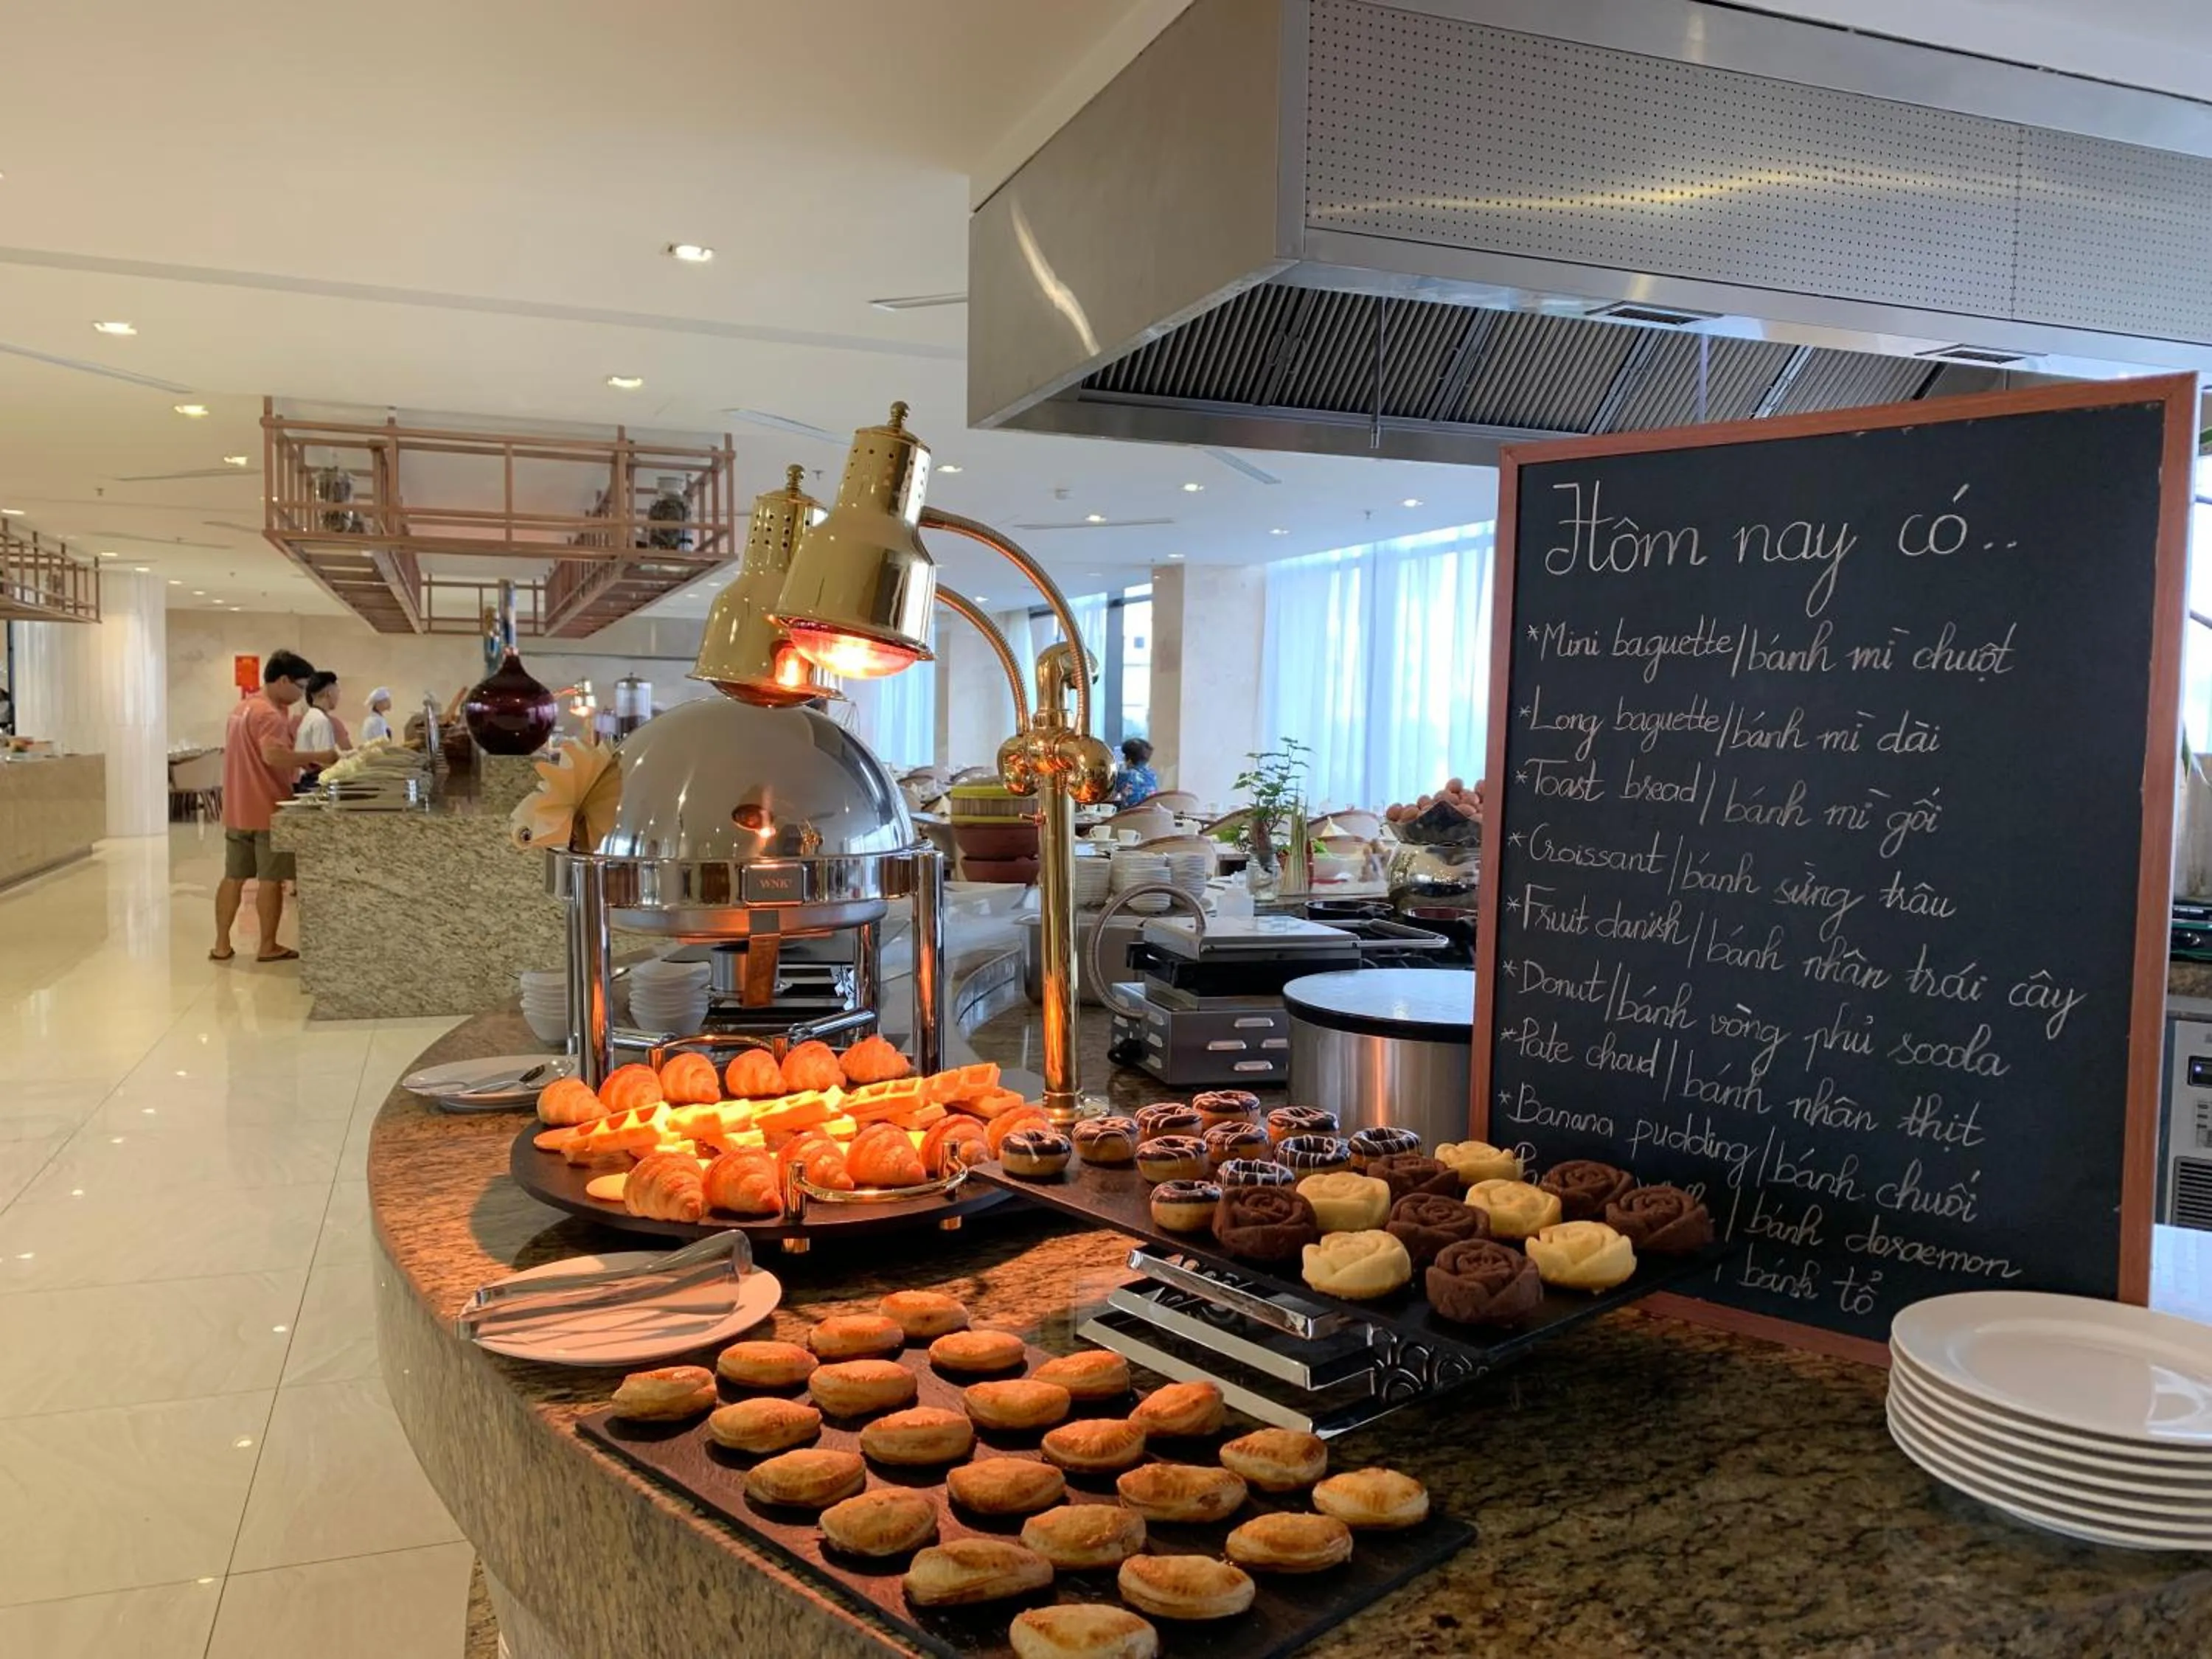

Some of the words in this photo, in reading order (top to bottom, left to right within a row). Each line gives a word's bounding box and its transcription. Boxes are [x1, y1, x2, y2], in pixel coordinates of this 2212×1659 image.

[1545, 480, 1707, 575] Hôm
[1733, 519, 1857, 617] nay
[1912, 622, 2018, 683] chuột
[1879, 871, 1957, 918] trâu
[1803, 936, 1892, 990] nhân
[1906, 944, 1989, 1001] trái
[2008, 970, 2088, 1040] cây
[1886, 1023, 2011, 1077] socola
[1787, 1077, 1879, 1132] nhân
[1896, 1093, 1986, 1153] thịt
[1875, 1158, 1982, 1223] chuối
